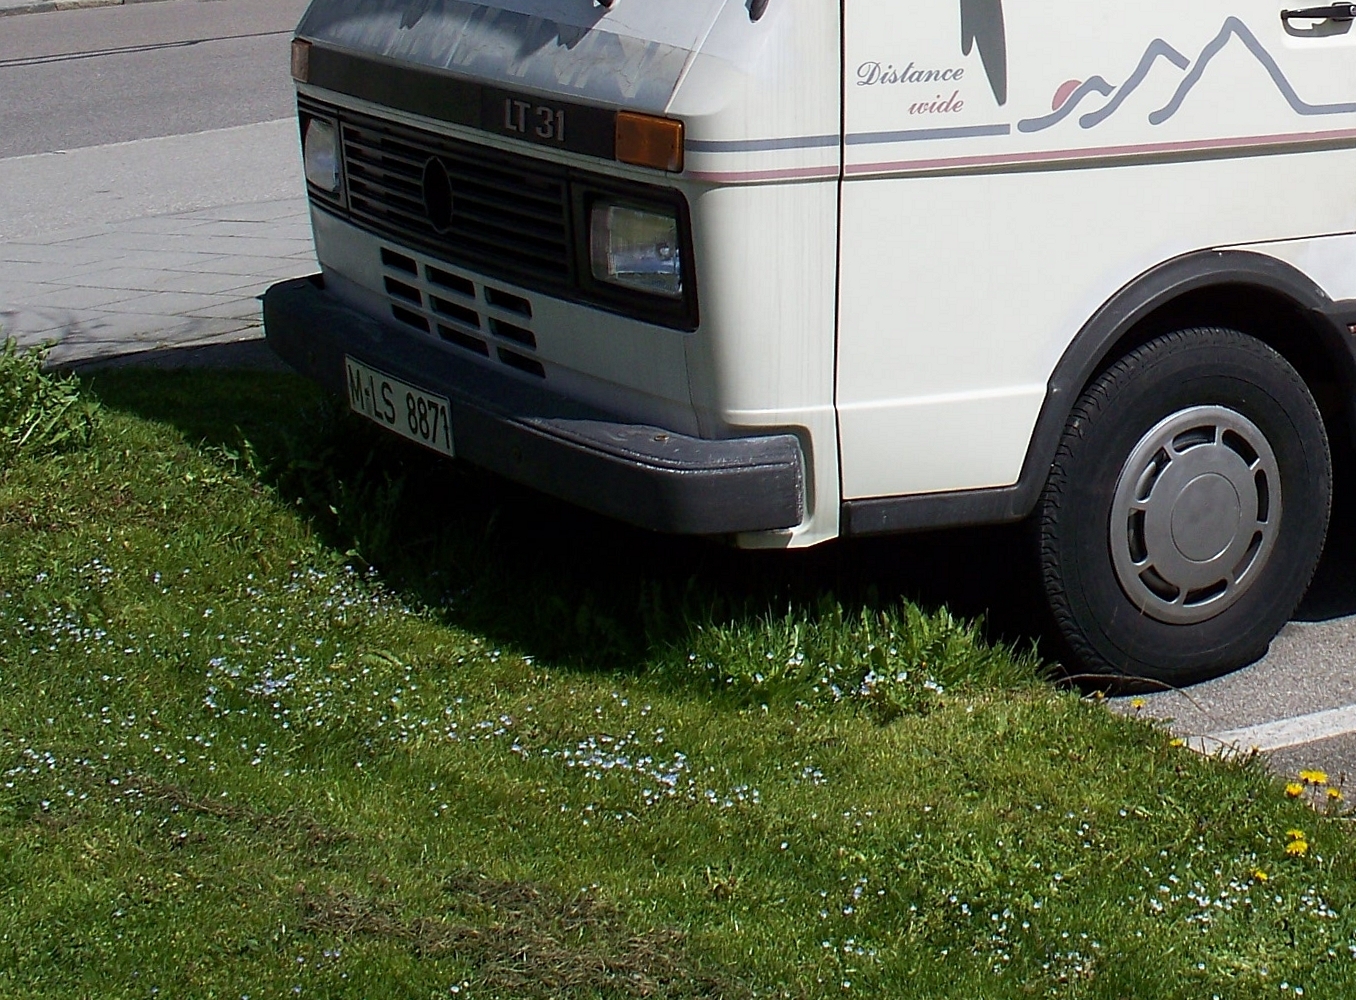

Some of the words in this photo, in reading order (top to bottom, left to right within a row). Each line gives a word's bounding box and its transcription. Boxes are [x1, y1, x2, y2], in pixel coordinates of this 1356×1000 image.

[856, 60, 965, 87] Distance
[907, 89, 965, 115] wide
[503, 98, 532, 133] LT
[535, 106, 566, 142] 31
[405, 391, 451, 450] 8871
